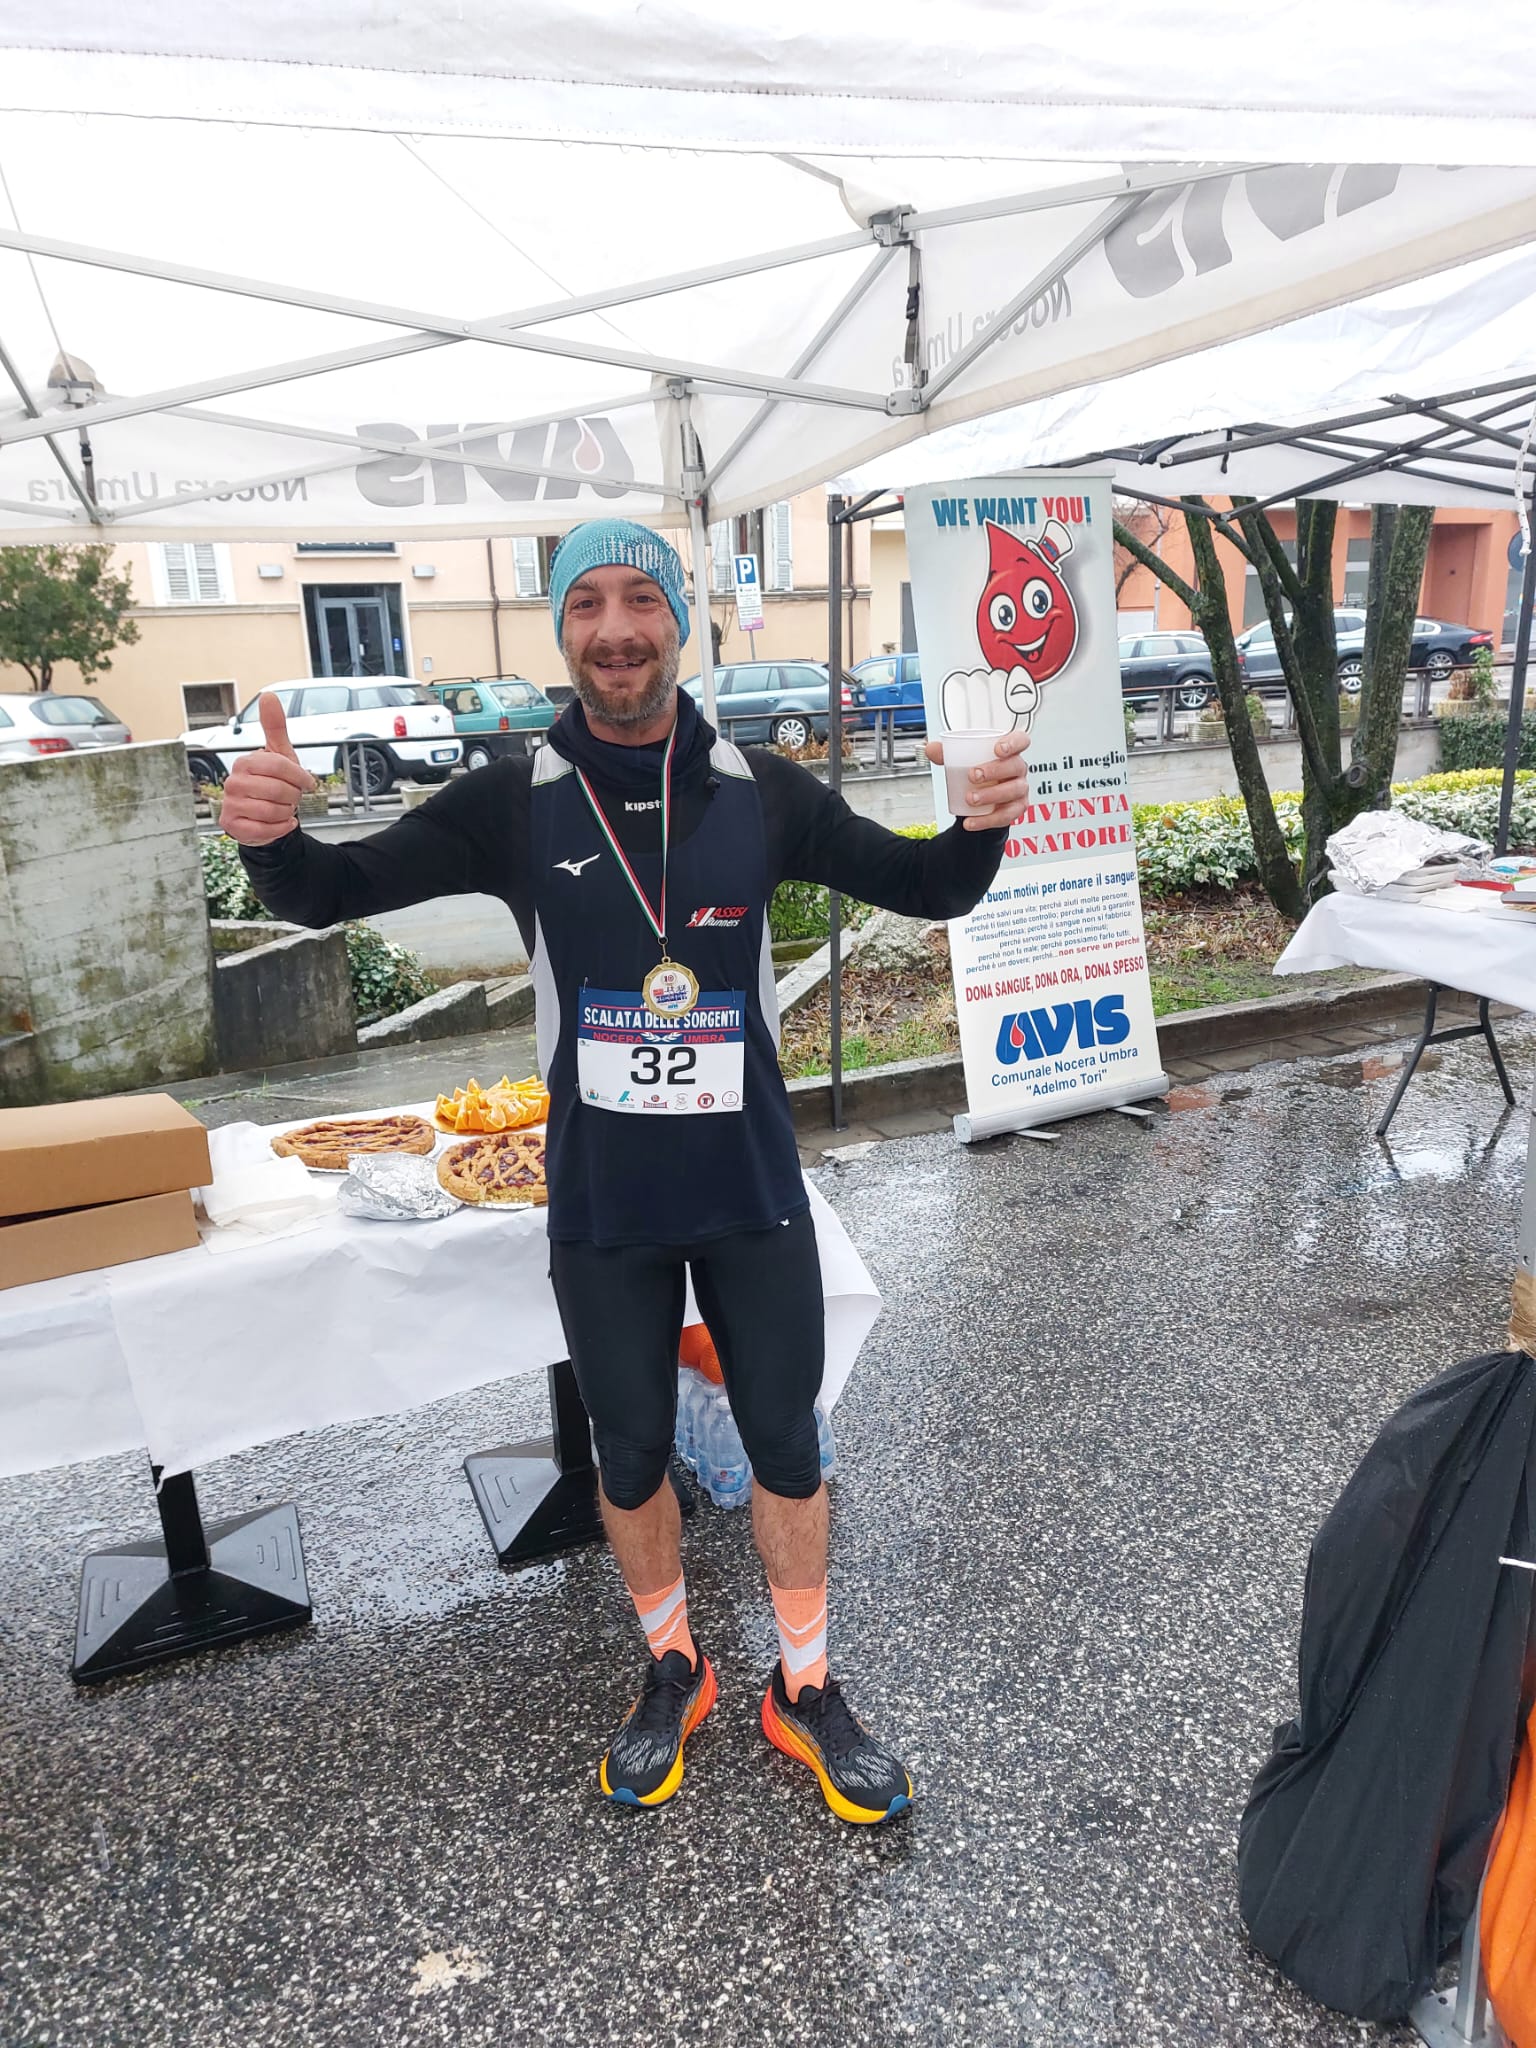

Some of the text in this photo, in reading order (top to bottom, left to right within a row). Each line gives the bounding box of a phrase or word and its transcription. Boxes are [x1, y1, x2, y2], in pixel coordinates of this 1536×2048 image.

[931, 496, 1092, 527] WE WANT YOU!
[738, 558, 752, 583] P
[1028, 750, 1126, 774] ona il meglio
[1037, 781, 1053, 795] di
[1058, 781, 1072, 793] te
[624, 799, 662, 812] kipst
[1004, 823, 1132, 859] ONATORE
[987, 886, 1012, 903] buoni
[1013, 882, 1039, 899] motivi
[1042, 881, 1057, 897] per
[1059, 877, 1093, 892] donare
[1096, 873, 1102, 887] il
[996, 909, 1012, 918] salvi
[1063, 897, 1079, 907] aiuti
[1080, 895, 1099, 904] molte
[1048, 929, 1062, 938] solo
[1063, 926, 1084, 937] pochi
[1055, 919, 1080, 928] sangue
[1002, 949, 1015, 957] non
[1064, 935, 1098, 946] possiamo
[1076, 944, 1100, 953] serve
[965, 955, 1145, 1003] DONA SANGUE, DONA ORA, DONA SPESSO
[584, 1006, 642, 1029] SCALATA
[683, 1010, 740, 1029] SORGENTI
[592, 1032, 726, 1044] NOCERA UMBRA
[995, 994, 1131, 1066] AVIS
[630, 1046, 697, 1085] 32
[991, 1047, 1138, 1087] Comunale Nocera Umbra
[1026, 1068, 1107, 1097] "Adelmo Tori"
